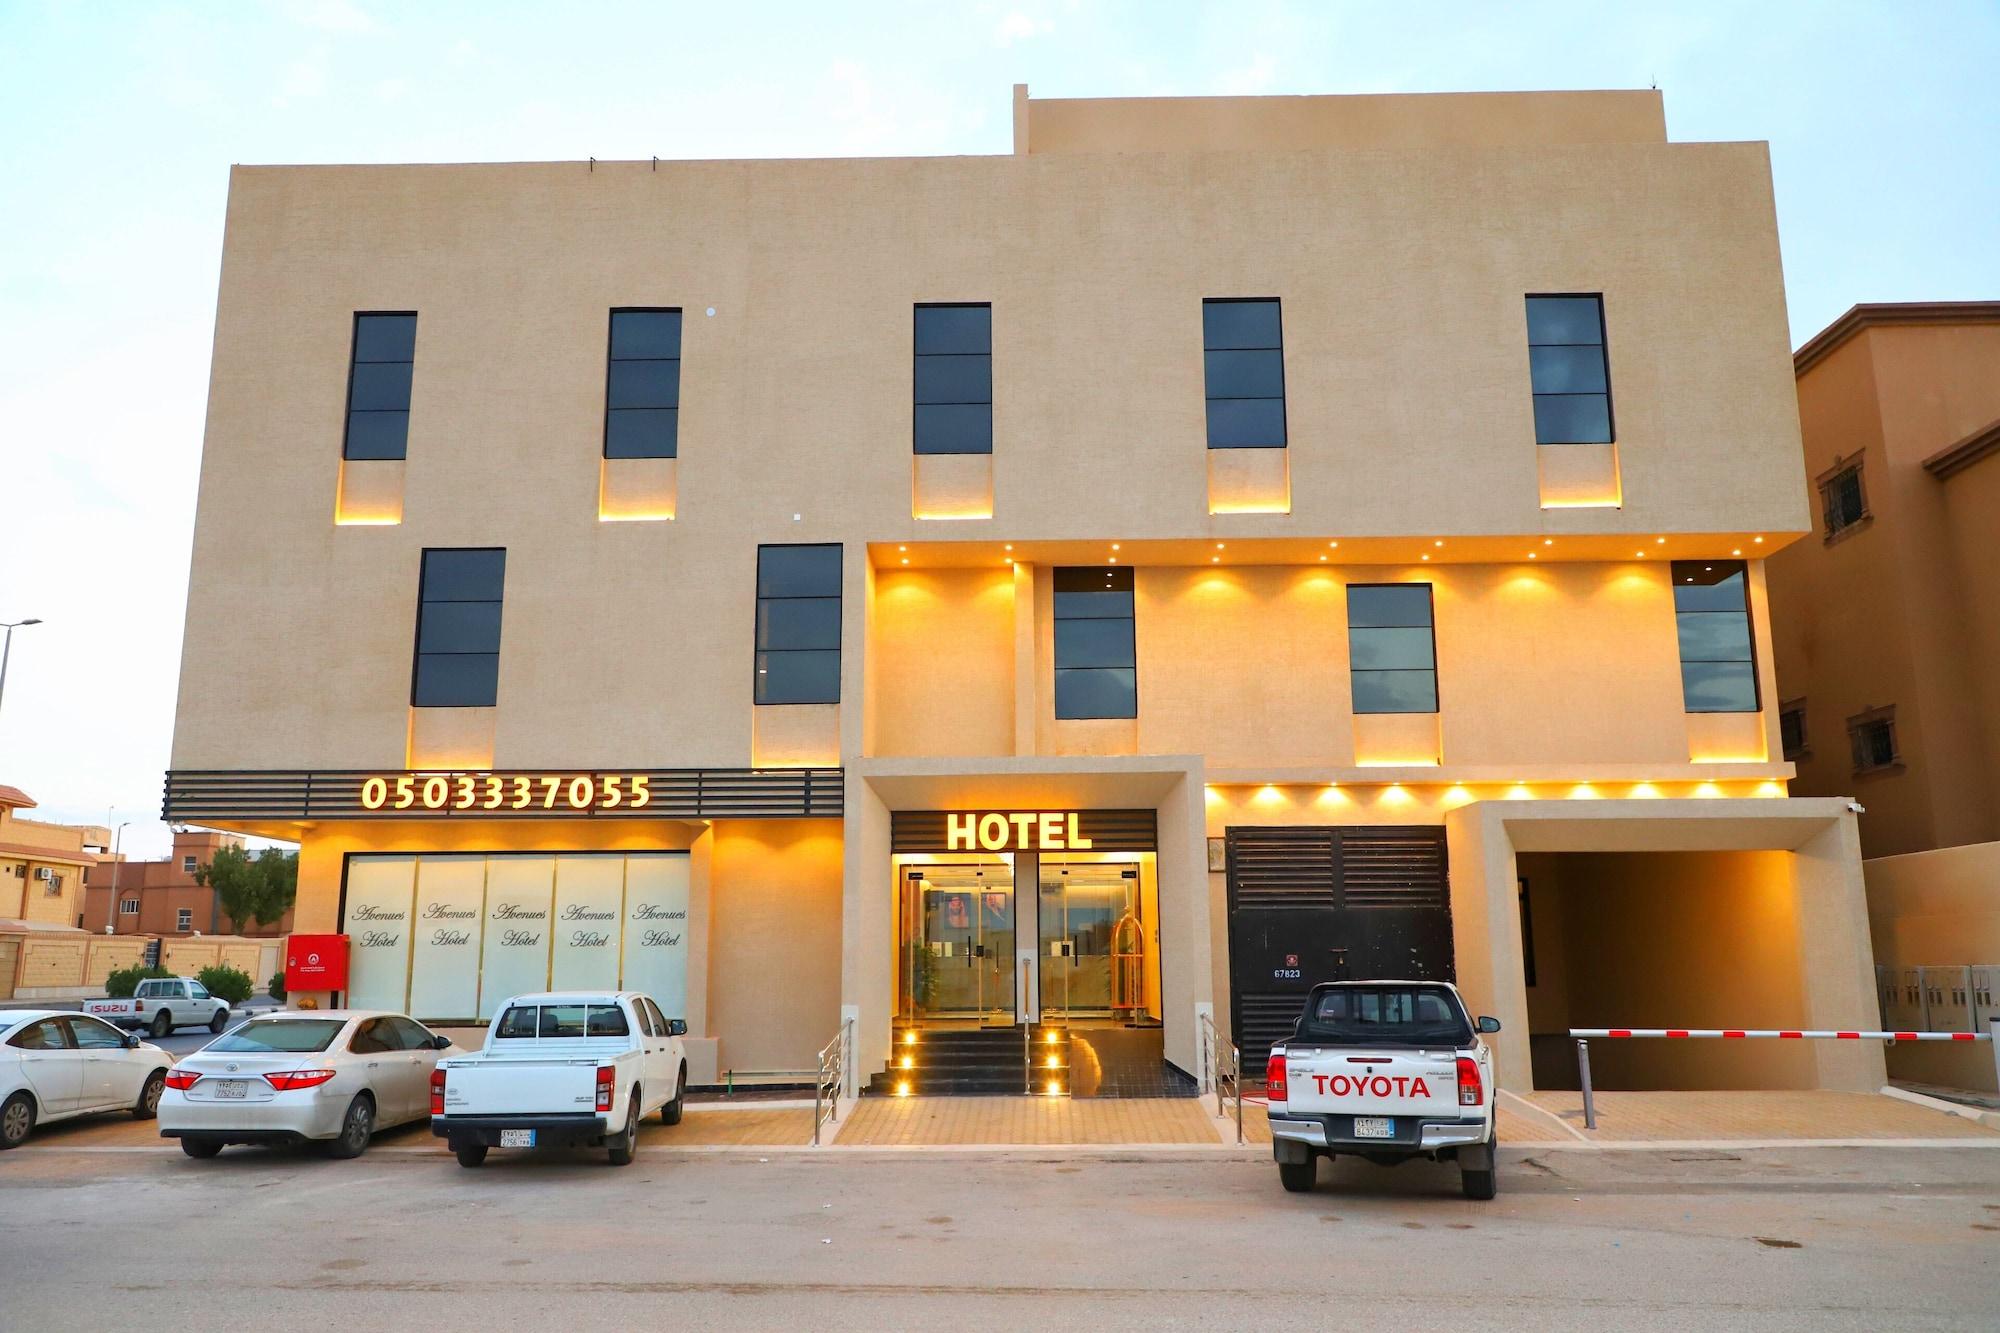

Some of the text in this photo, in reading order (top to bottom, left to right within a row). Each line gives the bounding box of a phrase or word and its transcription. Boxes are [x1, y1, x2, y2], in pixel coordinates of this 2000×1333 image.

[361, 777, 650, 809] 0503337055
[947, 813, 1093, 851] HOTEL
[351, 904, 405, 920] Avenues
[422, 902, 476, 919] Avenues
[492, 903, 547, 920] Avenues
[561, 903, 616, 920] Avenues
[632, 903, 686, 920] Avenues
[360, 930, 399, 947] Hotel
[431, 929, 470, 946] Hotel
[501, 929, 541, 946] Hotel
[570, 930, 610, 947] Hotel
[641, 929, 681, 947] Hotel
[1274, 969, 1301, 978] 67823
[90, 1004, 128, 1013] ISUZU
[1312, 1075, 1431, 1098] TOYOTA
